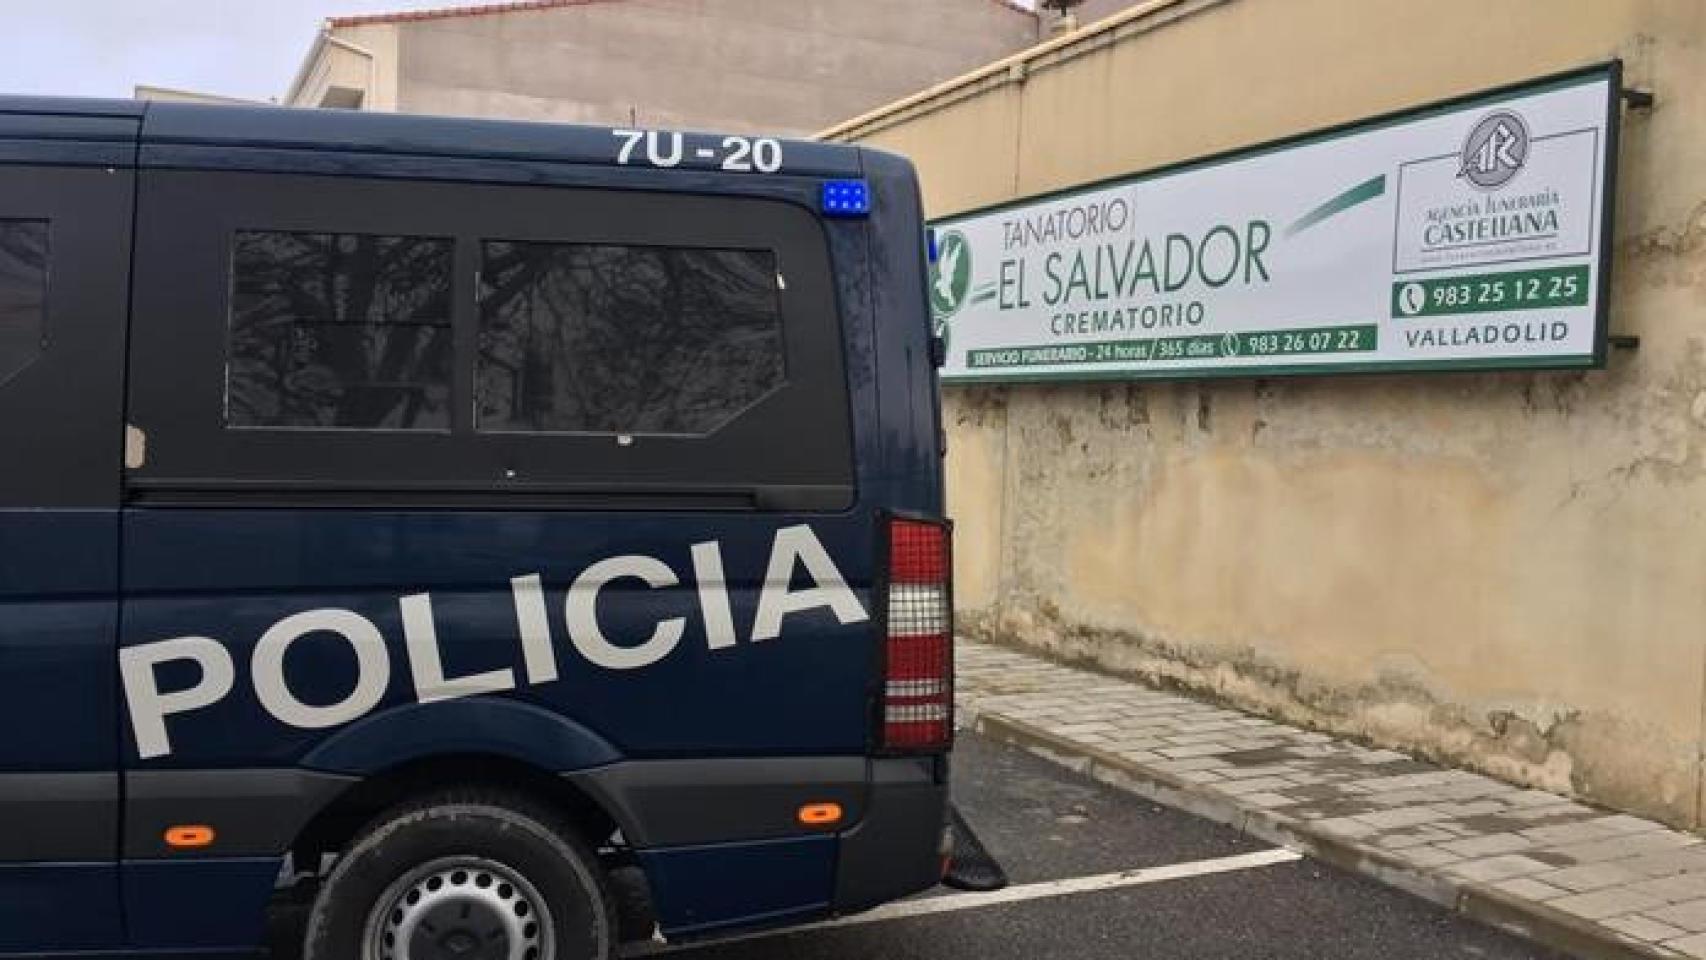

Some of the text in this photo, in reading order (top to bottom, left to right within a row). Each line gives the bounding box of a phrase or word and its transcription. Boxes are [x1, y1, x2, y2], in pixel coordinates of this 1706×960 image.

[1003, 198, 1128, 250] TANATORIO
[1423, 209, 1559, 245] CASTELLANA
[1000, 219, 1271, 310] EL SALVADOR
[1432, 275, 1578, 306] 983 25 12 25
[1050, 300, 1205, 336] CREMATORIO
[1405, 321, 1569, 347] VALLADOLID
[1159, 339, 1185, 356] 365
[1249, 329, 1360, 353] 983 26 07 22
[119, 523, 869, 759] POLICIA
